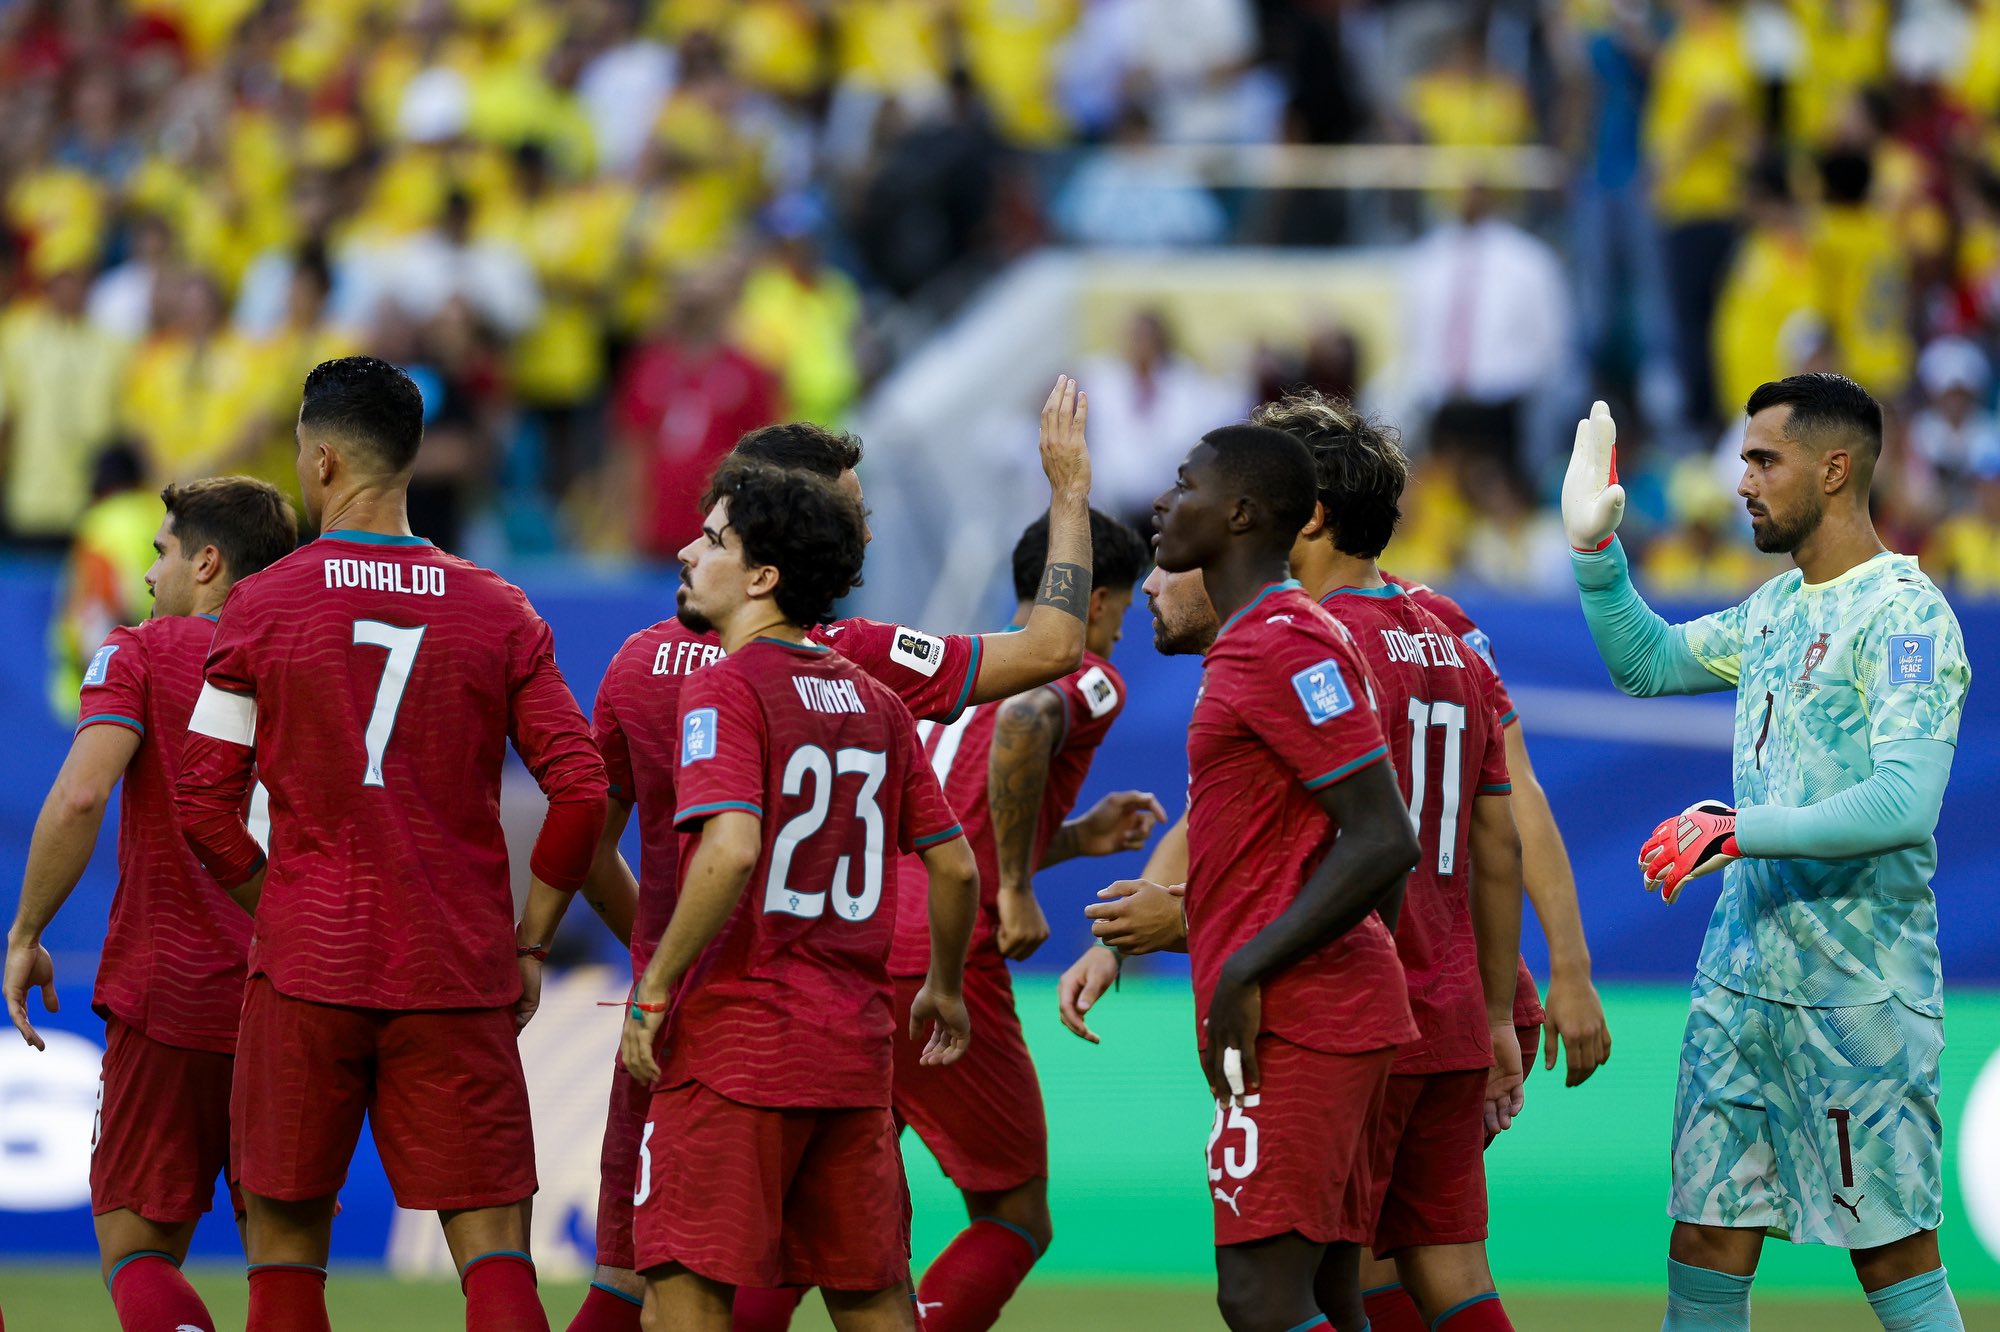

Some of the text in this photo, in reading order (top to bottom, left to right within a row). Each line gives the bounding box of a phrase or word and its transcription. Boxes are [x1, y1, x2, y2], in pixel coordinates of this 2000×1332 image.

[324, 558, 446, 597] RONALDO
[353, 618, 428, 788] 7
[792, 675, 866, 713] VITINHA
[1900, 664, 1922, 673] PEACE
[1755, 690, 1774, 770] 1
[1407, 695, 1467, 876] 11
[763, 744, 887, 922] 23
[1206, 1093, 1261, 1181] 25
[1827, 1108, 1854, 1188] 1
